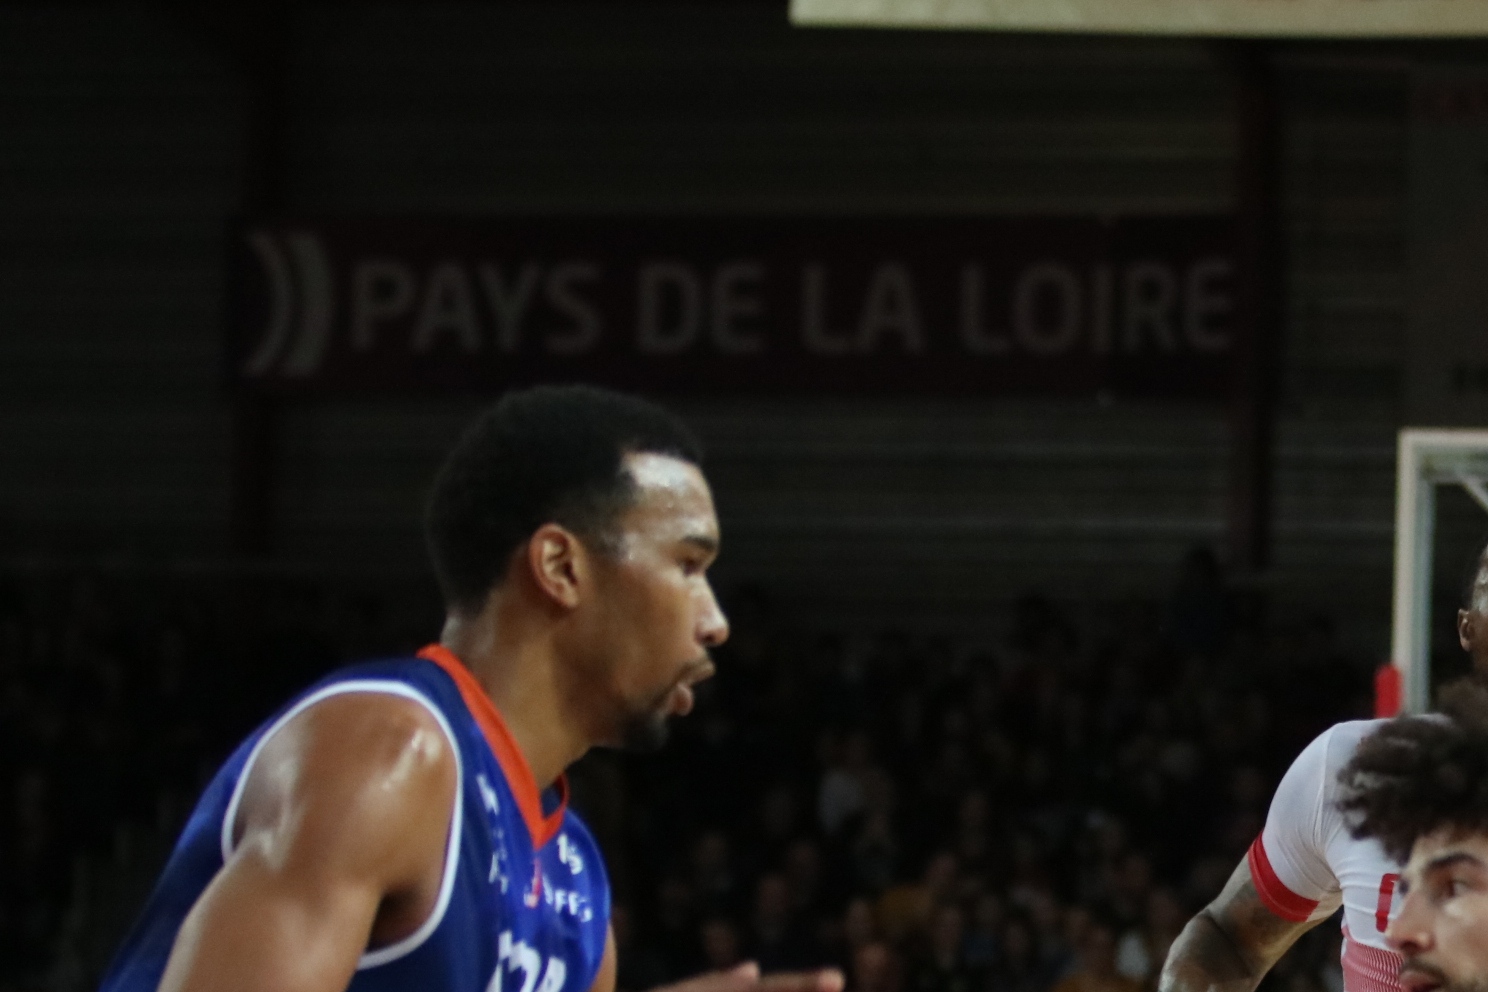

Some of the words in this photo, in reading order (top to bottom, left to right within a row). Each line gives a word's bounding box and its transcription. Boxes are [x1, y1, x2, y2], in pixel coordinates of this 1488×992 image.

[351, 259, 597, 354] PAYS
[636, 261, 765, 354] DE
[800, 261, 927, 354] LA
[958, 259, 1236, 354] LOIRE
